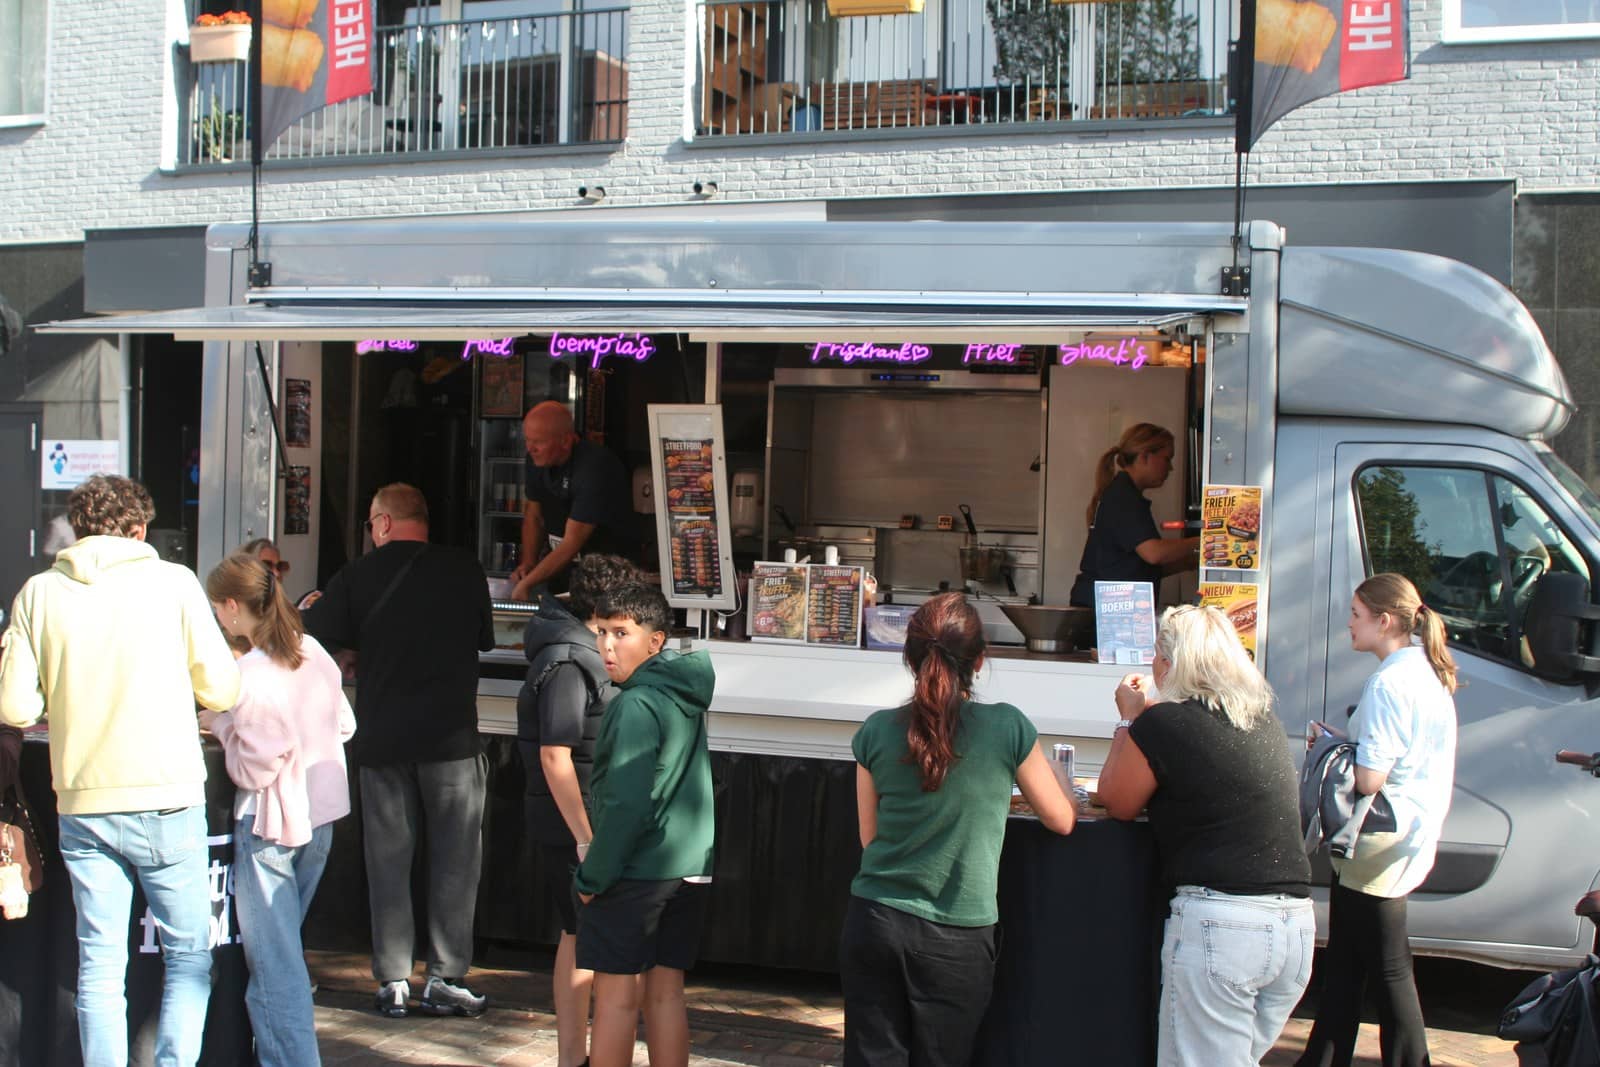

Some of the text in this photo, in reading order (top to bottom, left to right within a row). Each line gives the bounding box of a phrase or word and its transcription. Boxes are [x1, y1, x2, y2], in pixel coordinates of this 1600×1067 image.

[335, 0, 366, 69] HEE
[1205, 496, 1236, 508] FRIETJE
[764, 577, 787, 586] FRIET
[1205, 585, 1234, 597] NIEUW
